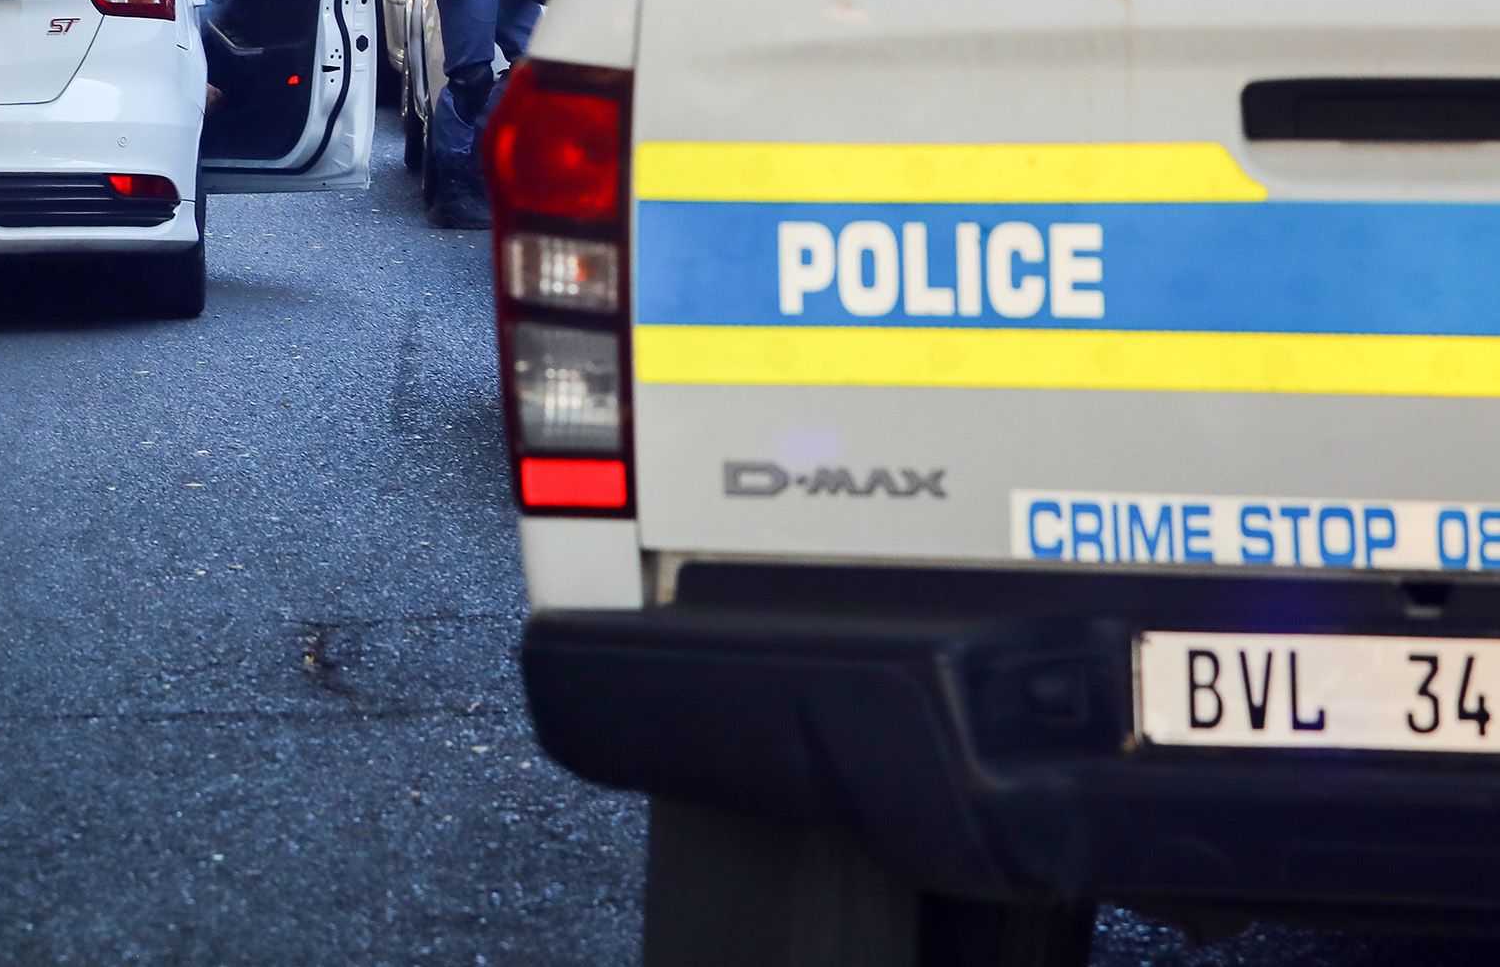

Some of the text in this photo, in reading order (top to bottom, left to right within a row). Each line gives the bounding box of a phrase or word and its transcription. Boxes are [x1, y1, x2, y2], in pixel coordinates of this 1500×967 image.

[48, 17, 80, 33] ST
[777, 220, 1106, 319] POLICE
[1029, 500, 1214, 564] CRIME
[1239, 505, 1397, 568] STOP
[1186, 649, 1491, 737] BVL 34
